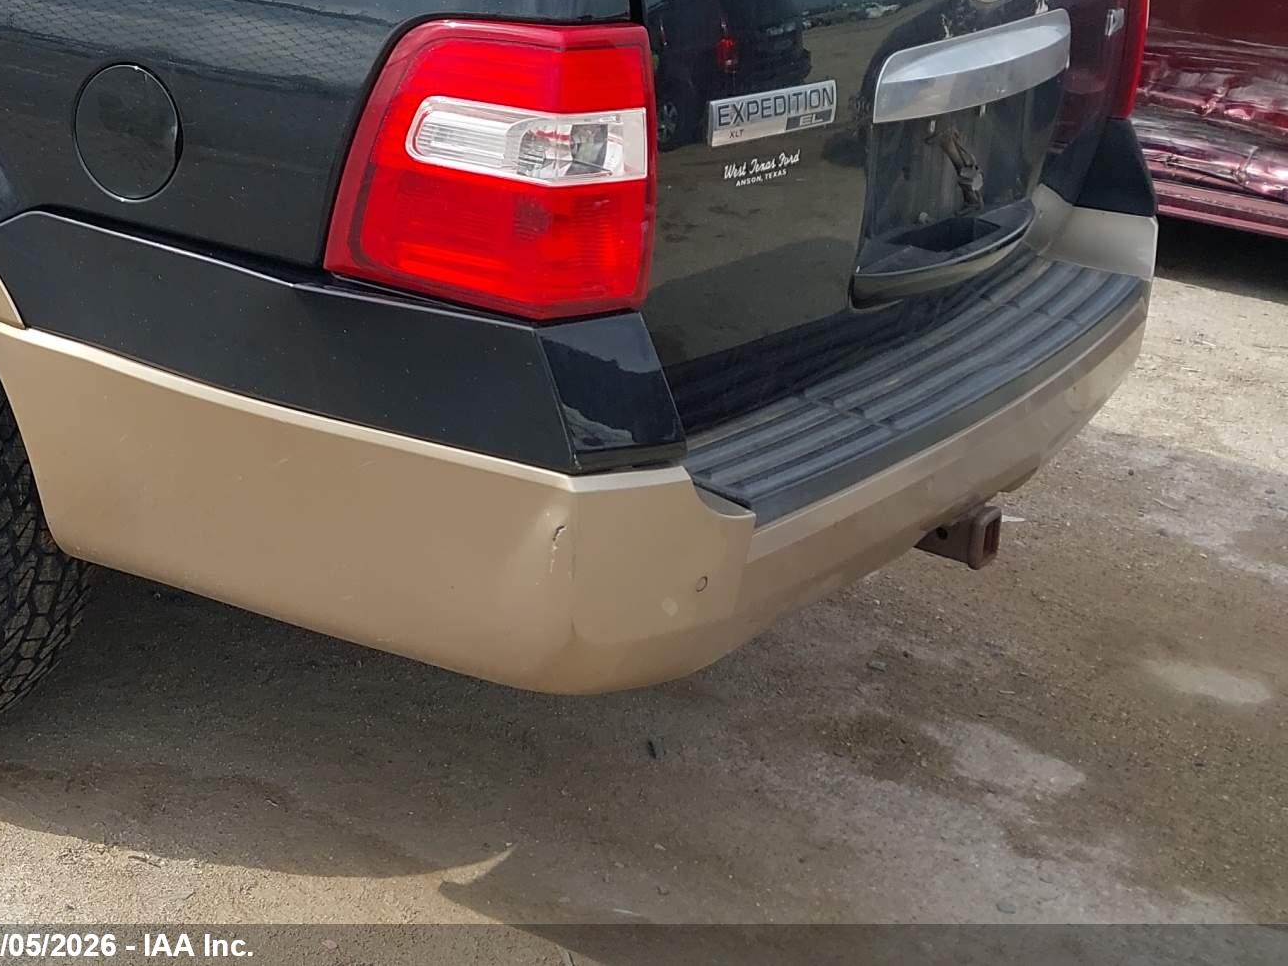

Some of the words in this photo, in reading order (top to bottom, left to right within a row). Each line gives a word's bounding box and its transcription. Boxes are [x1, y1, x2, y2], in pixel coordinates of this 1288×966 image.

[717, 86, 834, 126] EXPEDITION
[799, 114, 824, 126] EL
[729, 129, 745, 139] XLT
[723, 160, 747, 180] West
[749, 155, 777, 175] Texas
[778, 148, 801, 170] Ford
[735, 175, 763, 187] ANSON,
[765, 168, 787, 181] TEXAS
